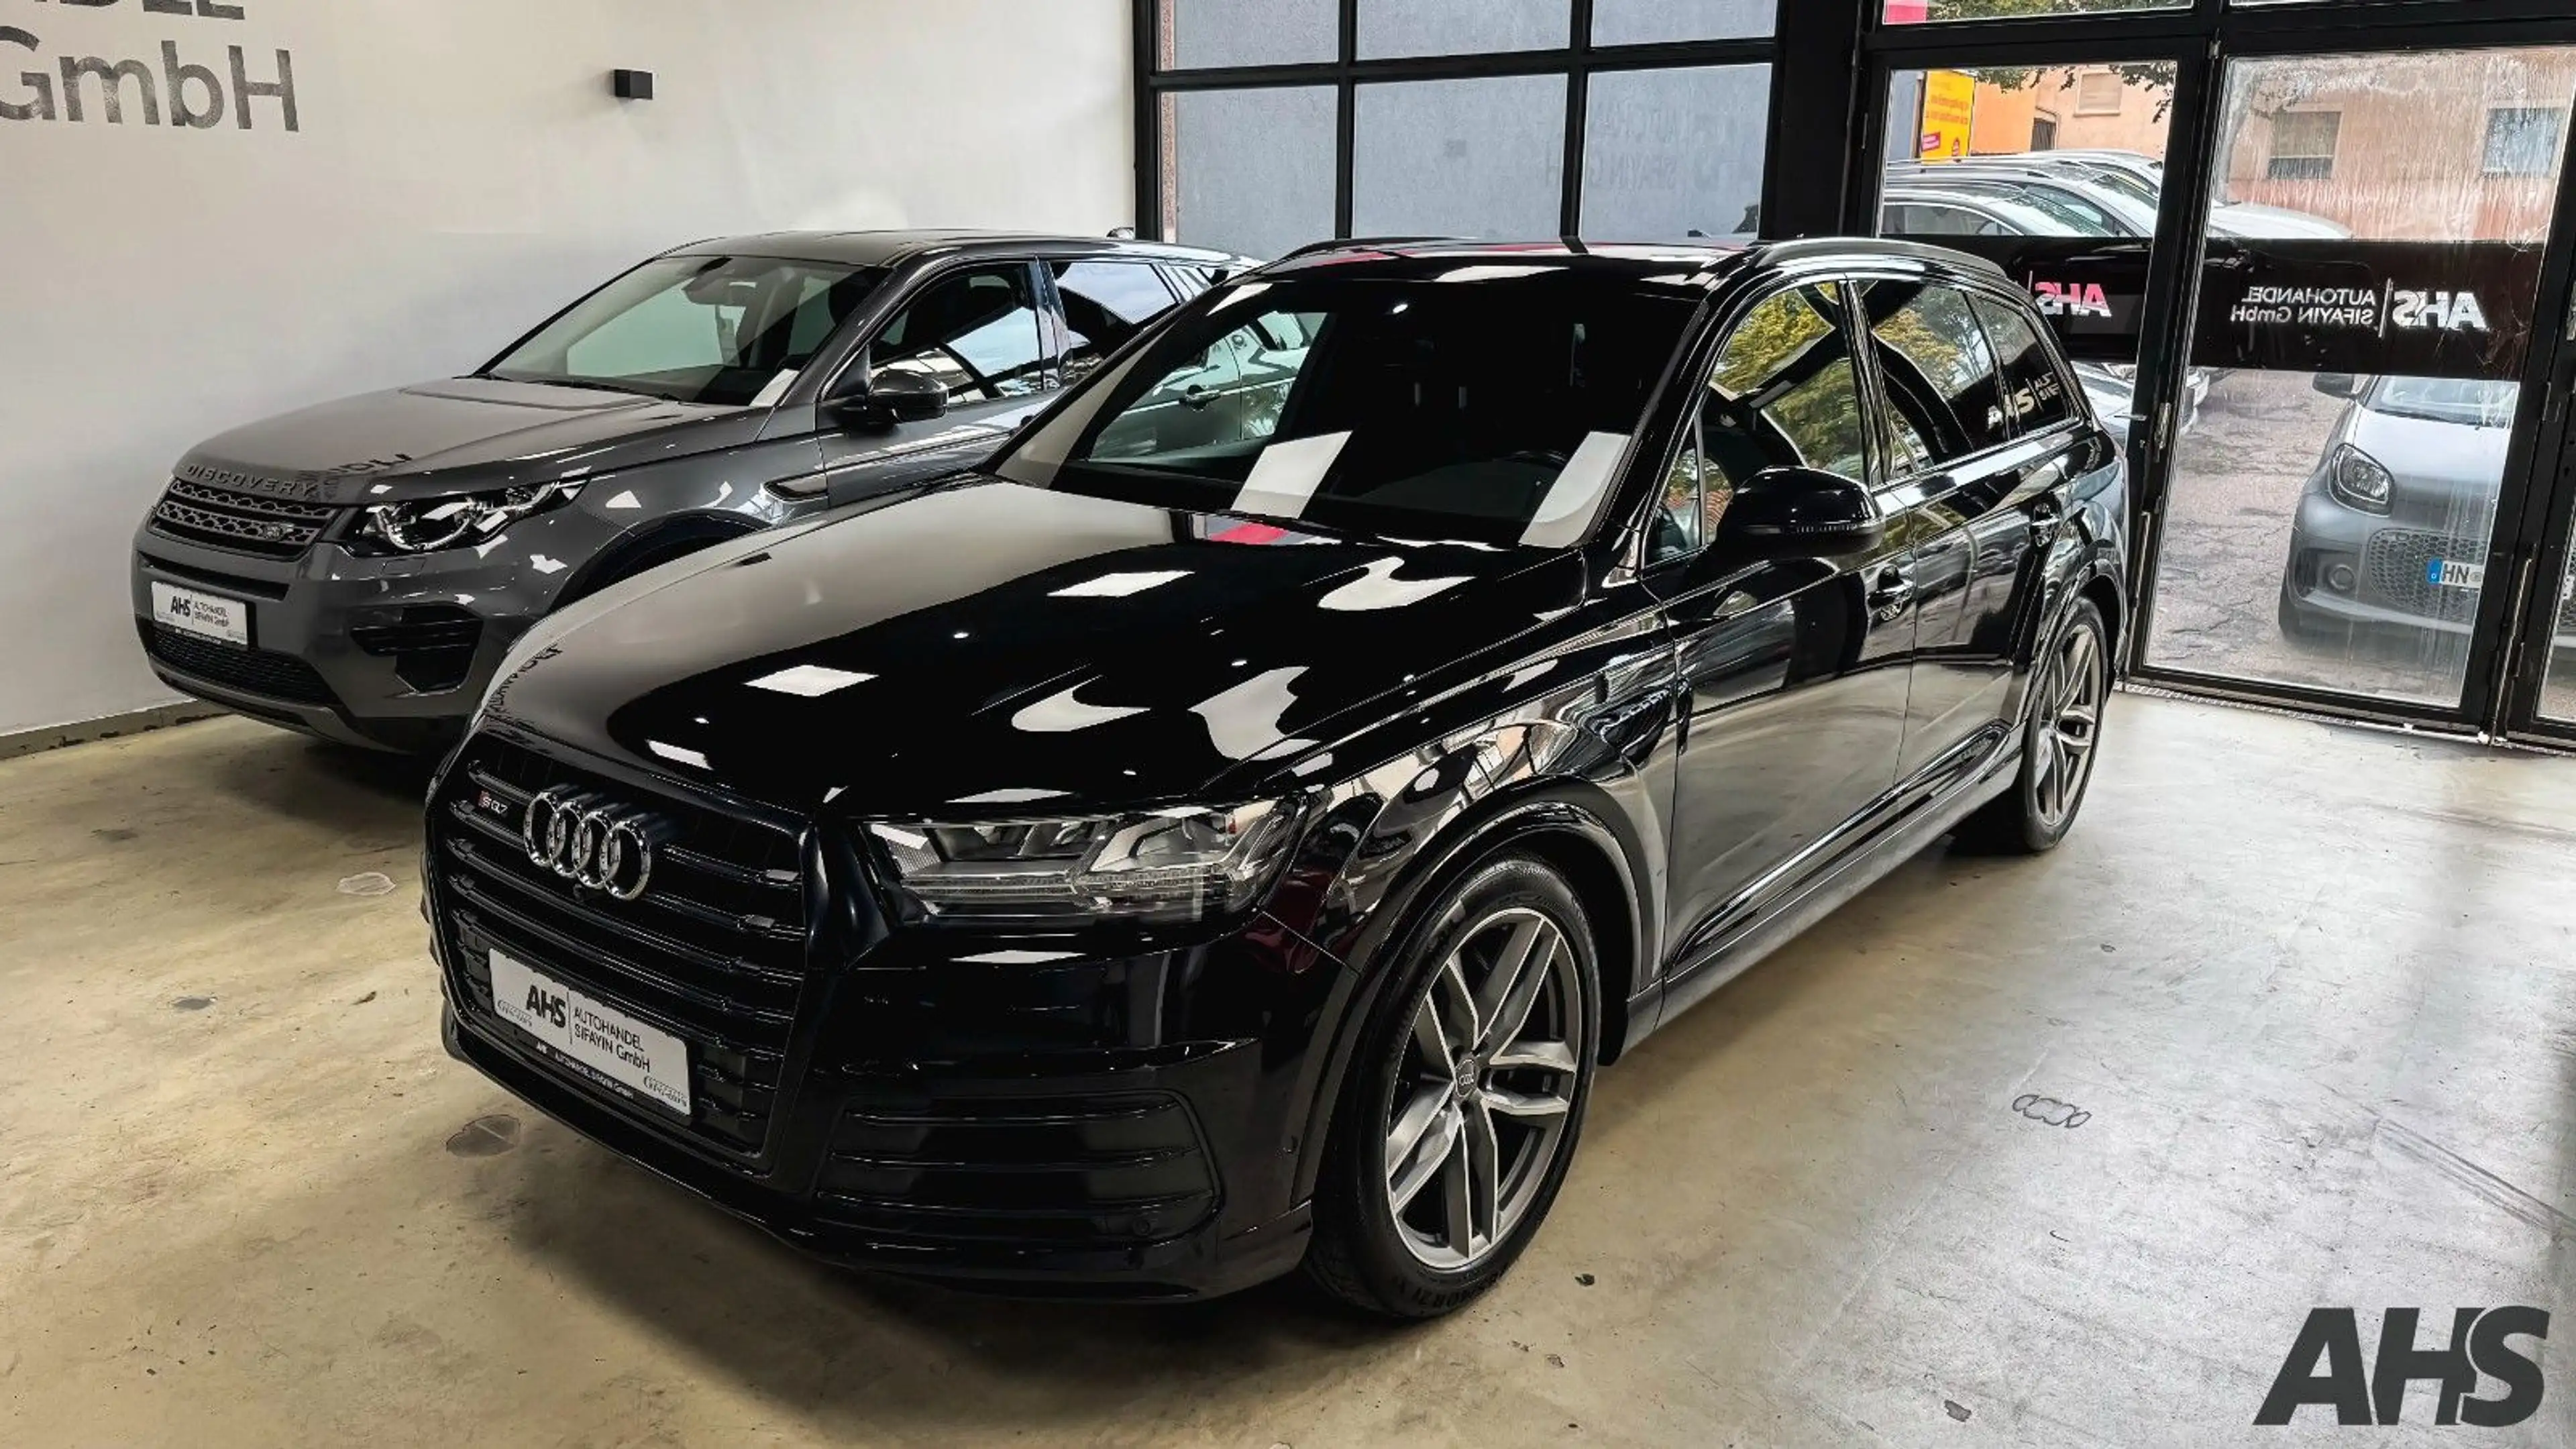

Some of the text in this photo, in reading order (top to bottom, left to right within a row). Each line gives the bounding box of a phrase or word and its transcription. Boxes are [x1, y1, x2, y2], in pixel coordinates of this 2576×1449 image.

[0, 25, 299, 132] GmbH
[186, 464, 319, 497] DISCOVERY
[2443, 564, 2469, 584] HN
[170, 595, 191, 618] AHS
[481, 792, 508, 814] SQ7
[526, 984, 566, 1028] AHS
[574, 1006, 645, 1053] AUTOHANDEL
[574, 1023, 613, 1054] SIFAYIN
[616, 1045, 651, 1073] GmbH
